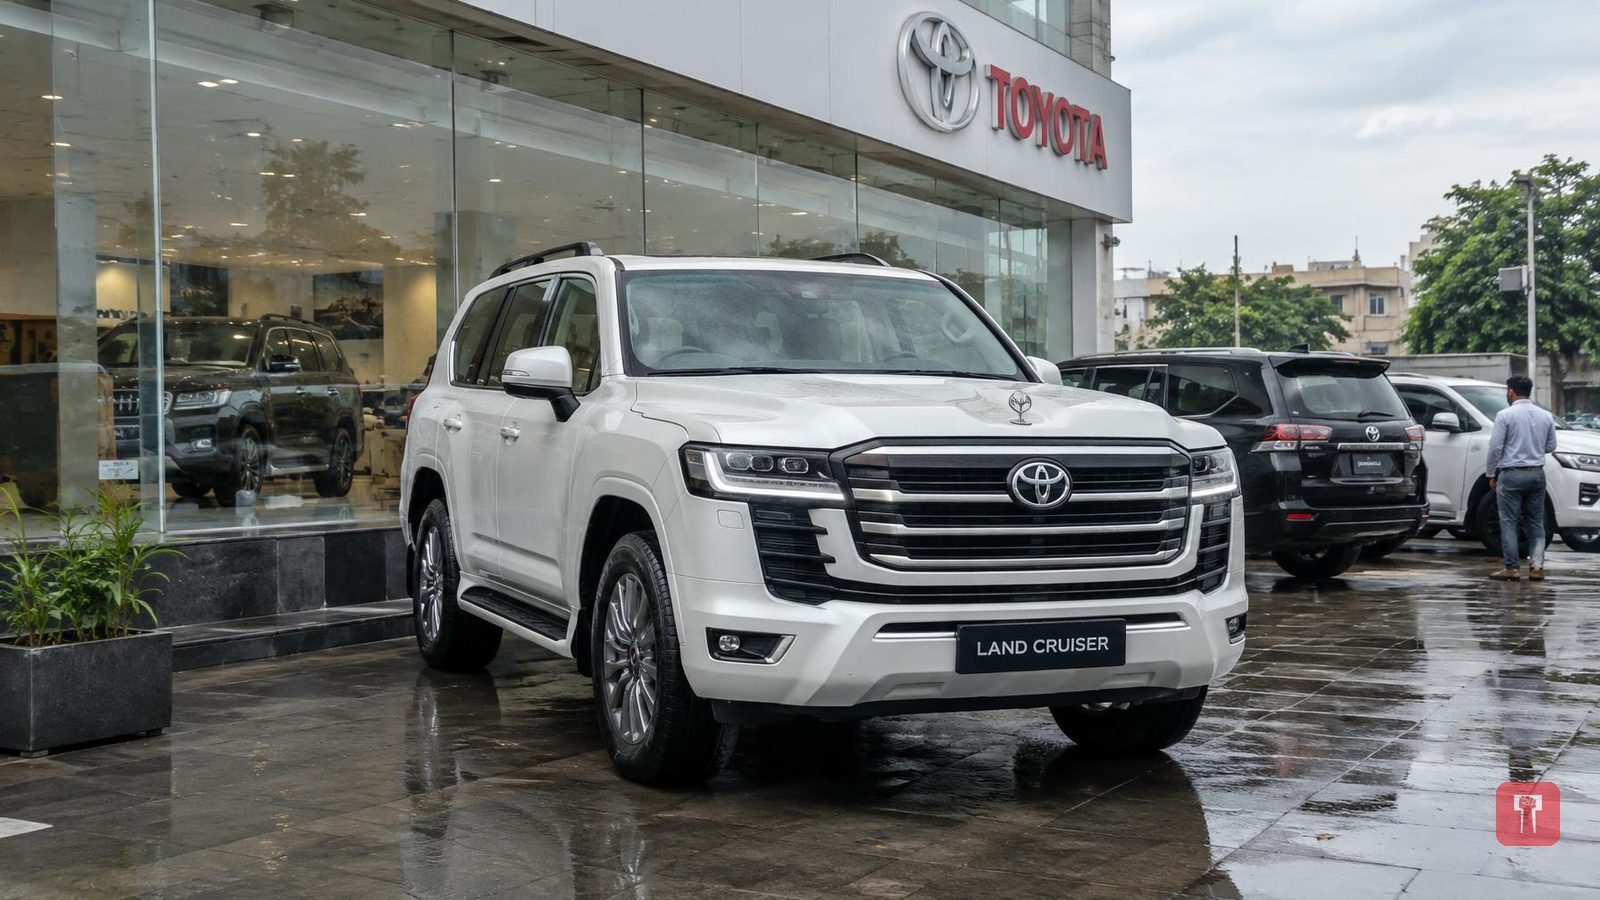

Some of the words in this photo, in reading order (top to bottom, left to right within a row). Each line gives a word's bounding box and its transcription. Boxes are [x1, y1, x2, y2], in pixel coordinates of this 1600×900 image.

[984, 63, 1108, 171] TOYOTA
[977, 640, 1028, 656] LAND
[1033, 636, 1109, 654] CRUISER
